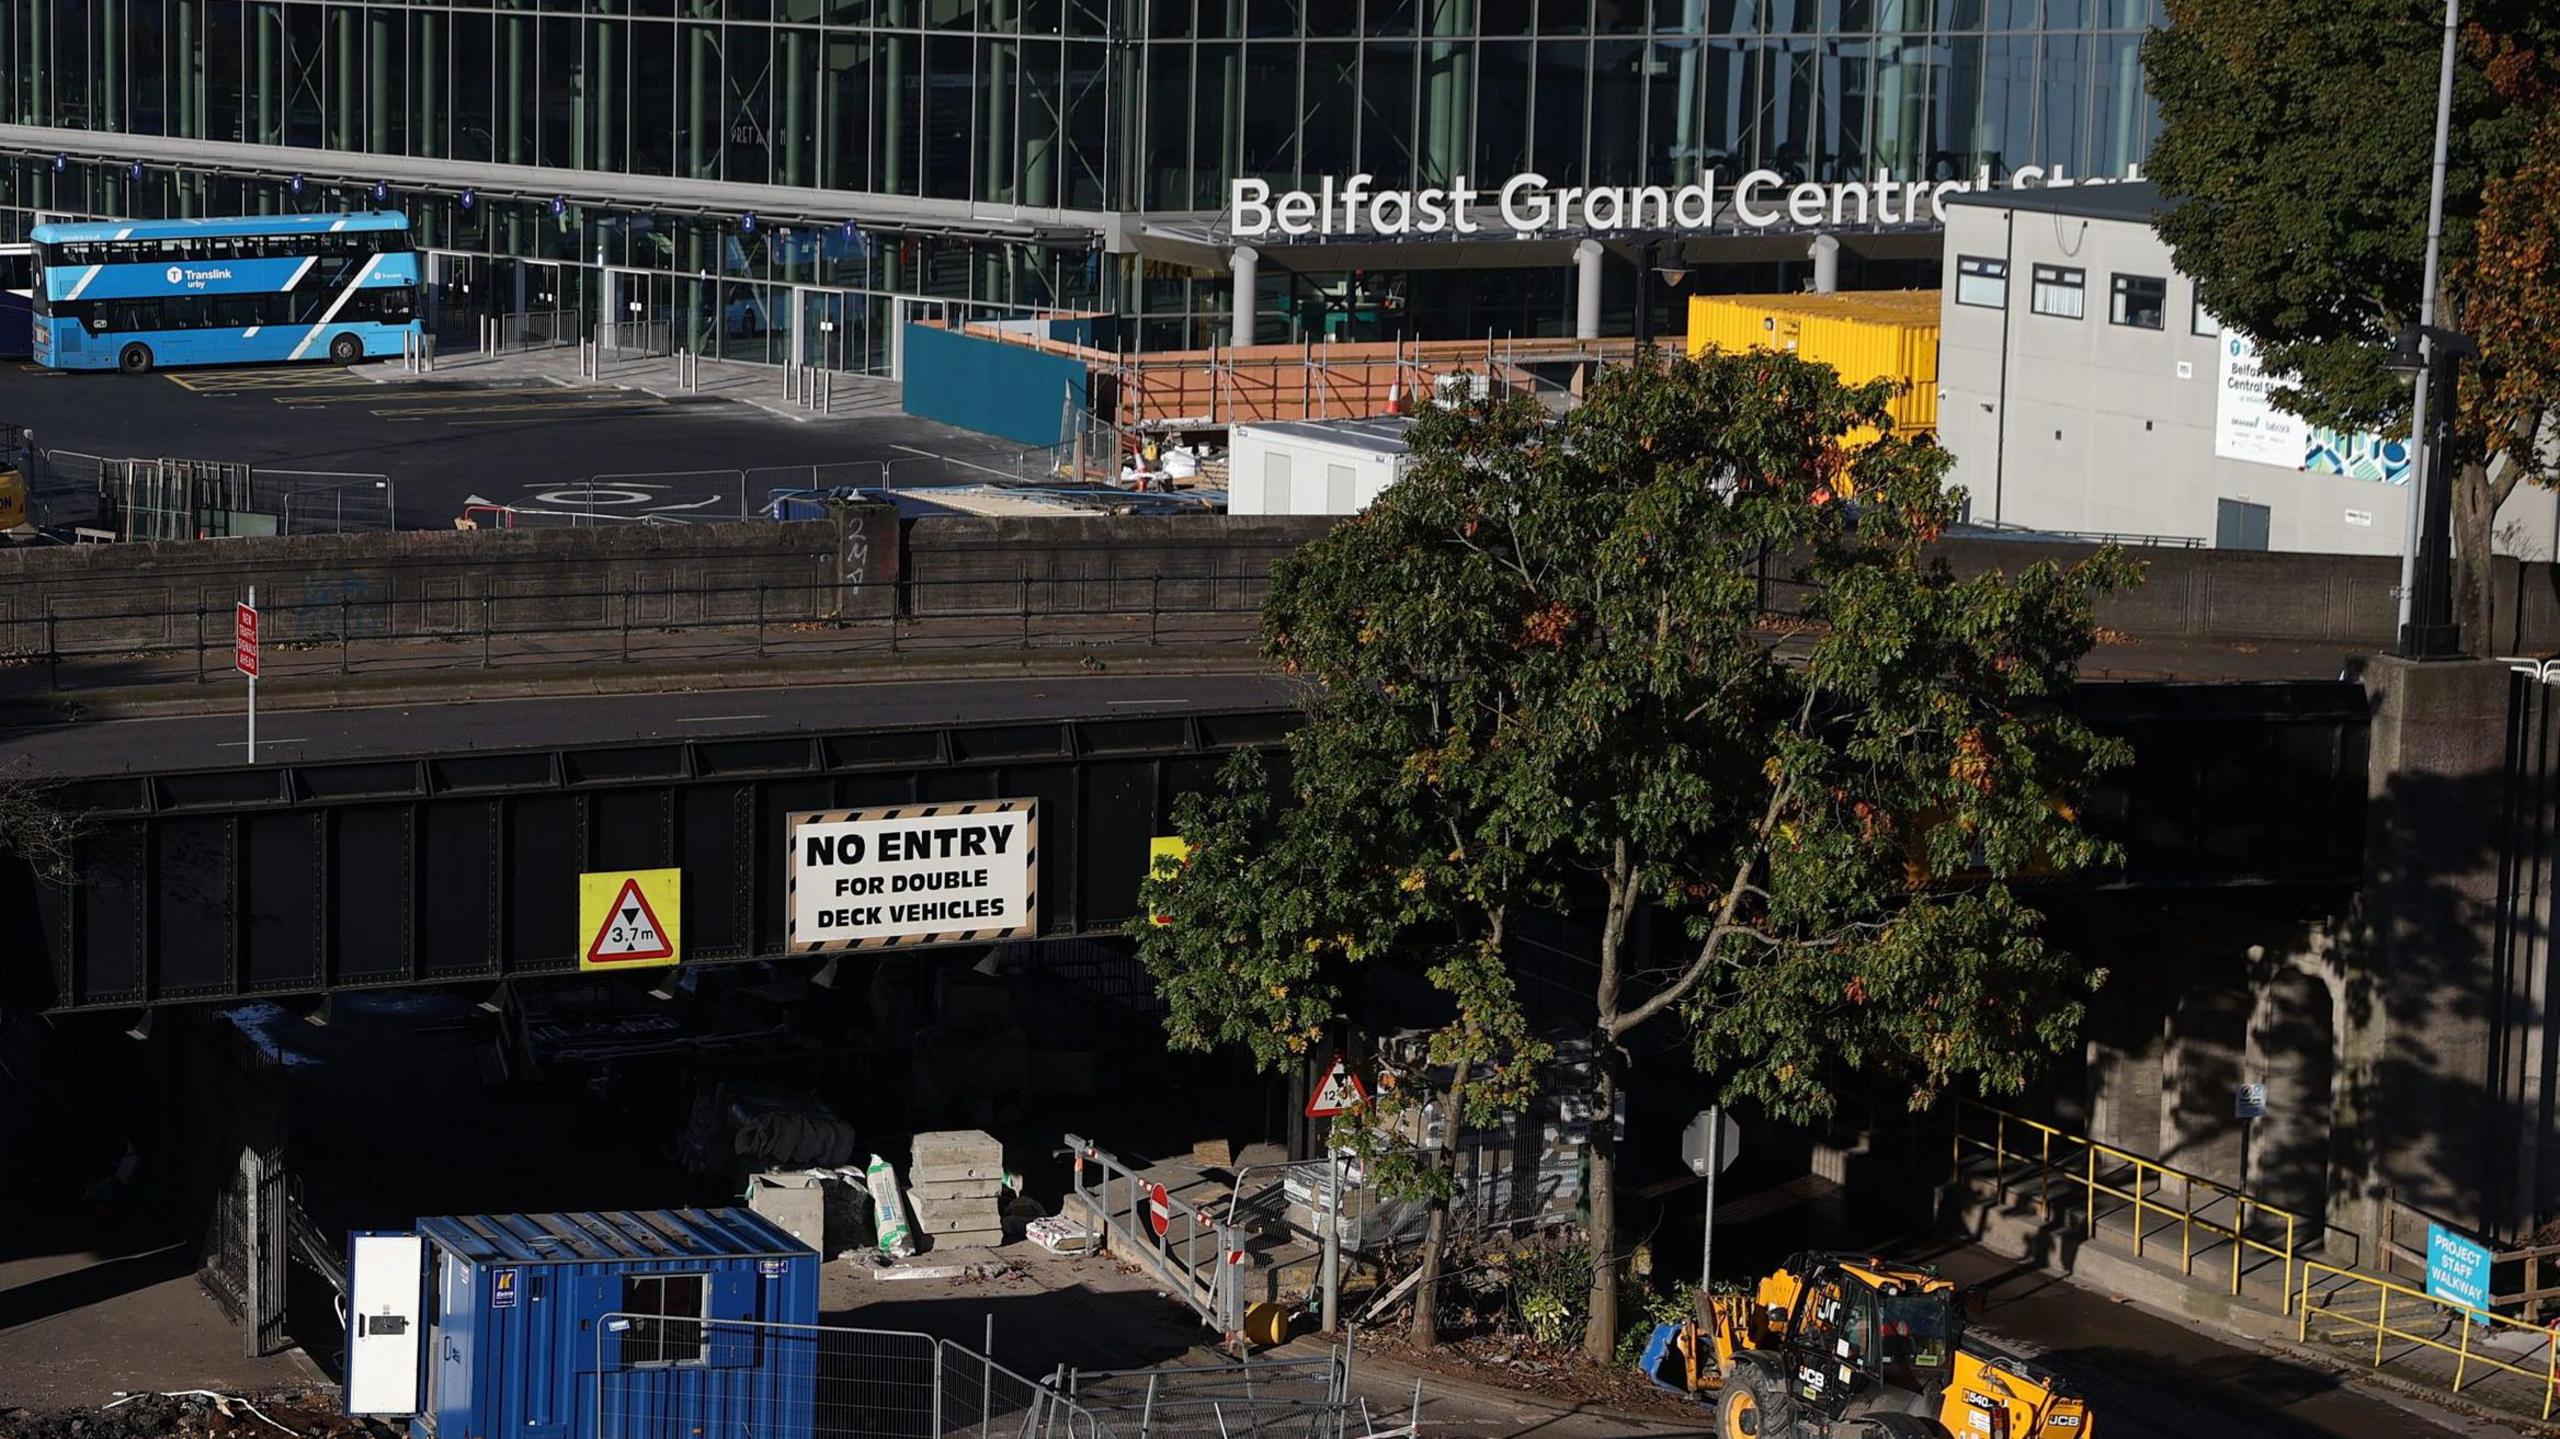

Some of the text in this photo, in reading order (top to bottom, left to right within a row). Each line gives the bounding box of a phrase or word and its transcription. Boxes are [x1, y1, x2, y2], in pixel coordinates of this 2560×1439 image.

[1231, 173, 1478, 237] Belfast
[1500, 168, 1715, 232] Grand
[185, 268, 232, 281] Translink
[187, 280, 206, 290] urby
[2228, 376, 2263, 393] Central
[242, 611, 253, 626] NEW
[240, 624, 255, 642] TRAFFIC
[239, 638, 256, 657] SIGNALS
[240, 653, 255, 670] AHEAD
[806, 824, 1014, 867] NO ENTRY
[835, 869, 988, 897] FOR DOUBLE
[818, 898, 1004, 928] DECK VEHICLES
[2435, 1234, 2482, 1267] PROJECT
[2441, 1254, 2473, 1279] STAFF
[2432, 1266, 2482, 1301] WALKWAY
[1818, 1299, 1841, 1327] JC
[1799, 1365, 1825, 1387] JCB
[2049, 1415, 2080, 1427] JCB
